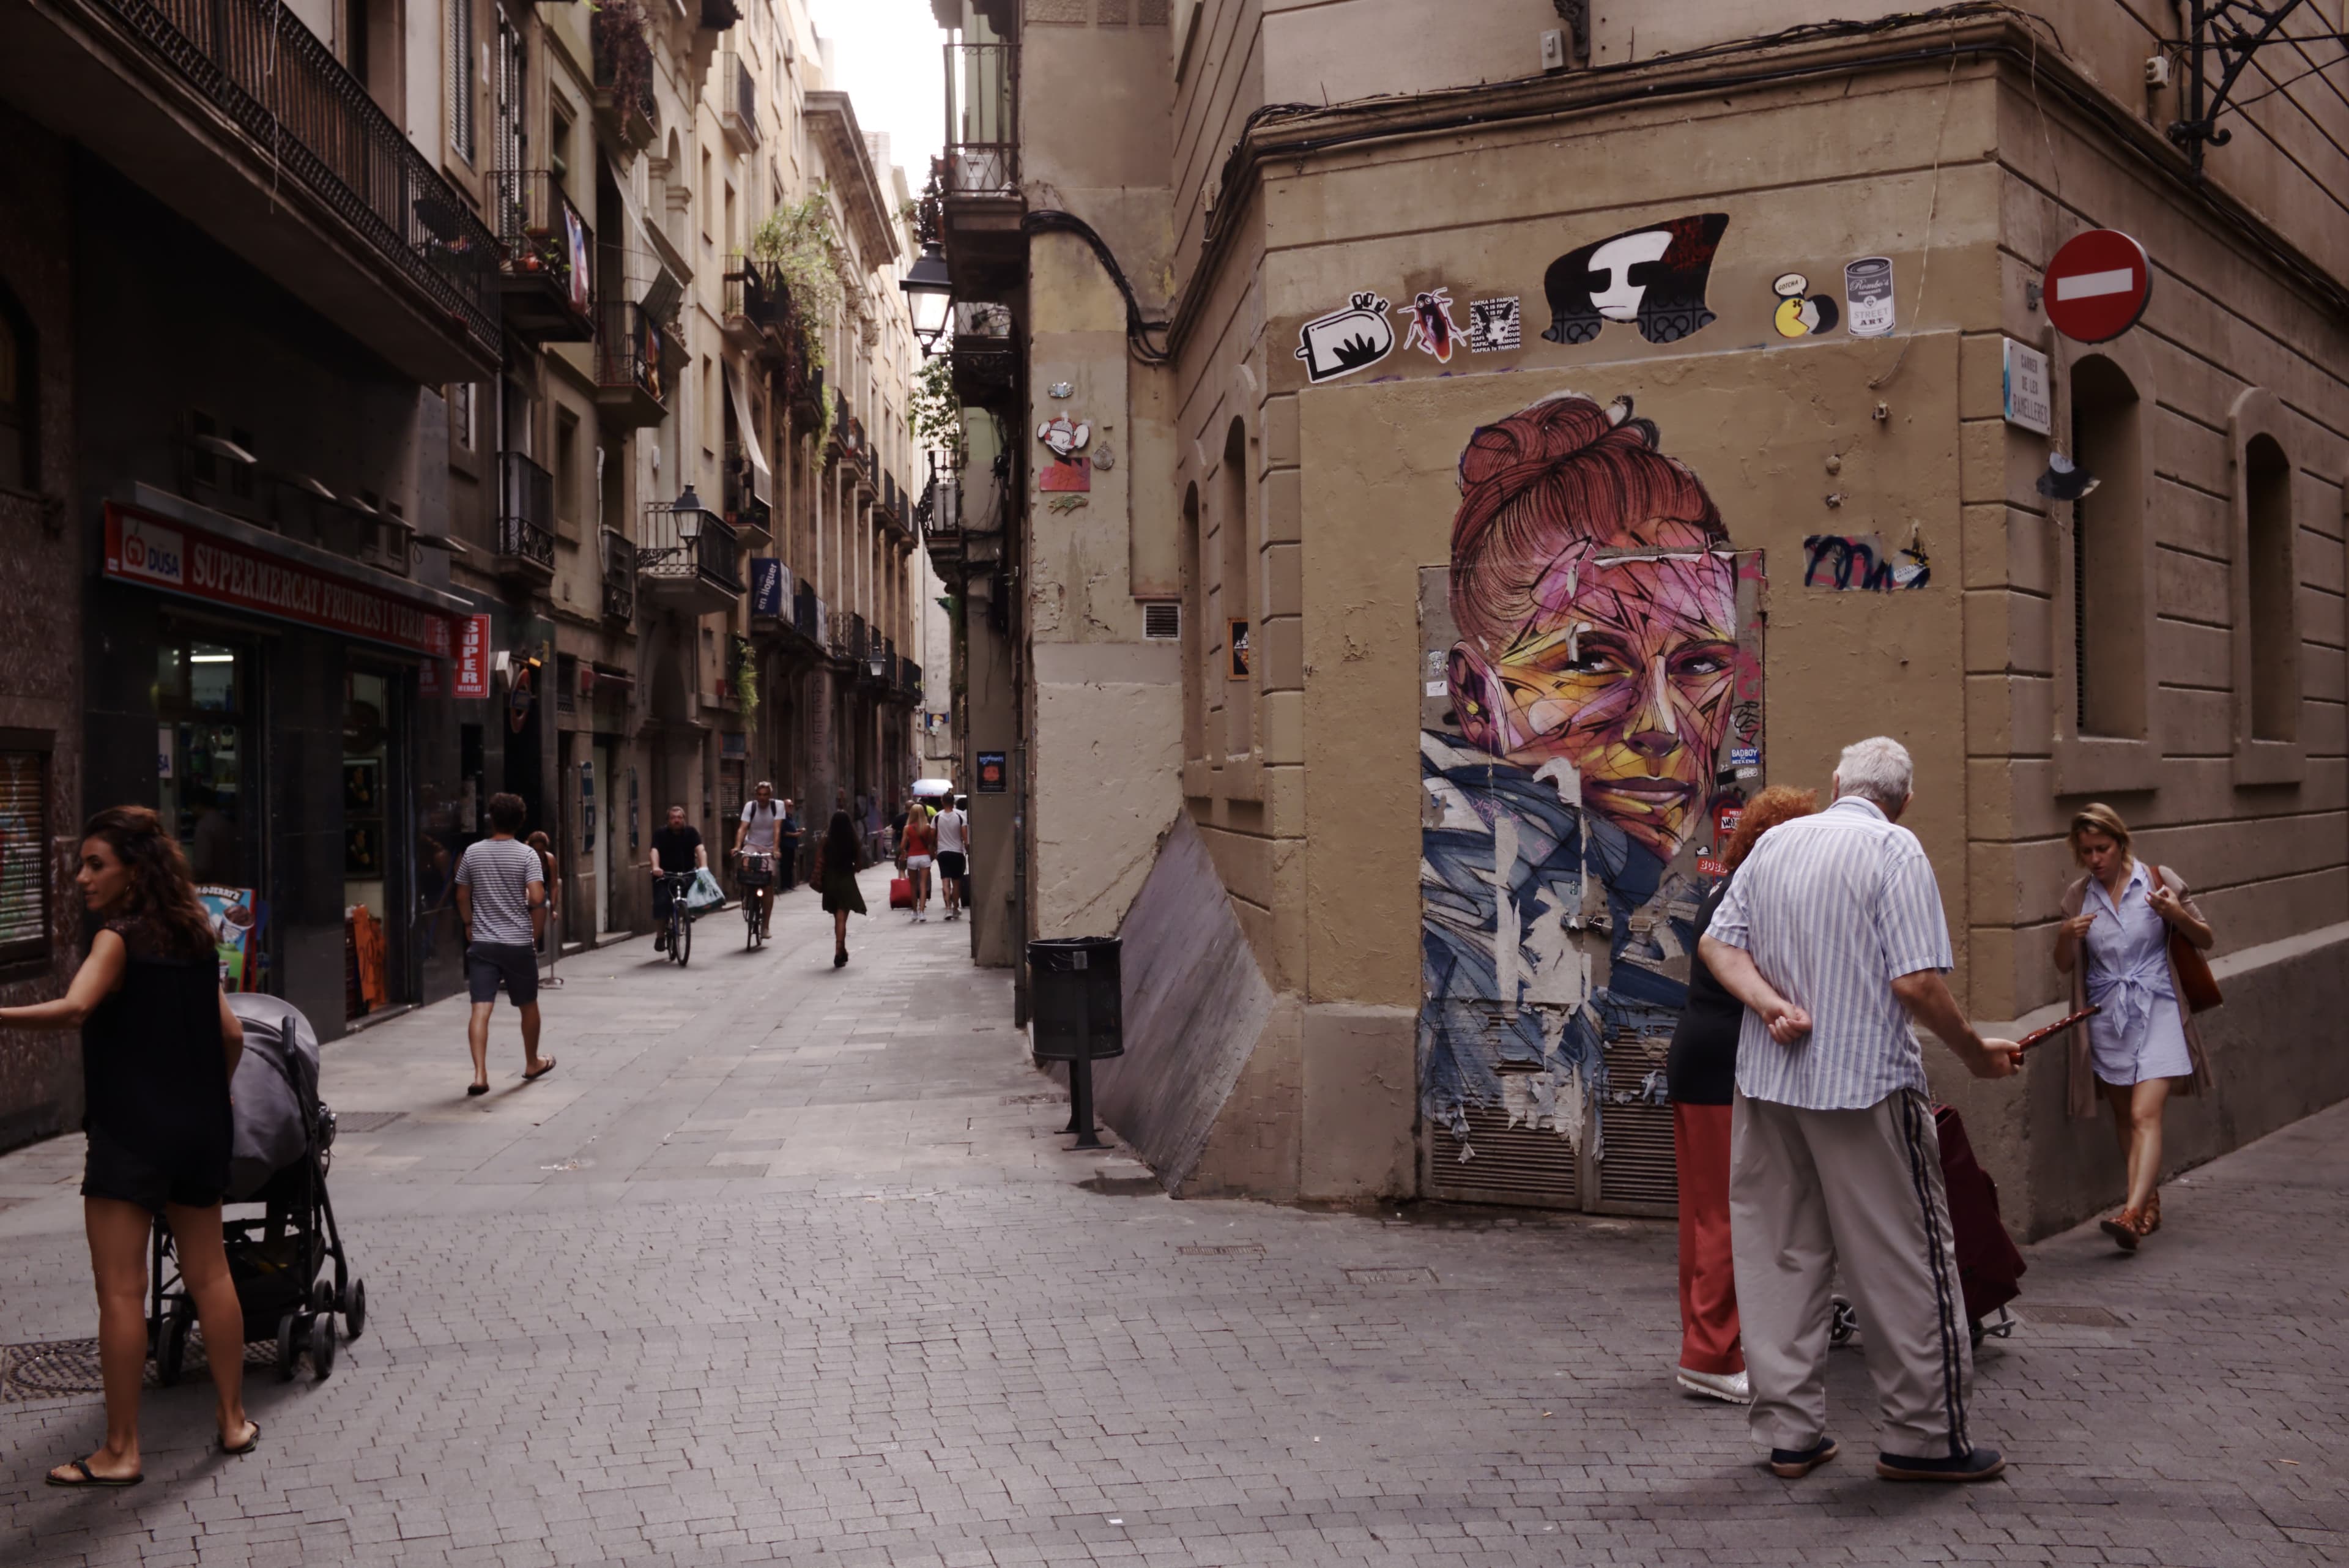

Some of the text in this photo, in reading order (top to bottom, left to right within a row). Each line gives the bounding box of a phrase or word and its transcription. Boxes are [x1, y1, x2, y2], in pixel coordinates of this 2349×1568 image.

[1778, 279, 1798, 291] GOTCHA
[1855, 307, 1888, 319] STREET
[2021, 354, 2038, 374] CARRER
[2022, 375, 2028, 392] DE
[2013, 393, 2048, 425] RAMELLERES
[148, 547, 179, 578] DUSA
[192, 542, 321, 615] SUPERMERCAT
[322, 581, 382, 631] FRUITES
[760, 563, 777, 596] lloguer
[759, 598, 768, 610] en
[462, 620, 479, 684] SUPER
[1732, 748, 1757, 757] BADBOY
